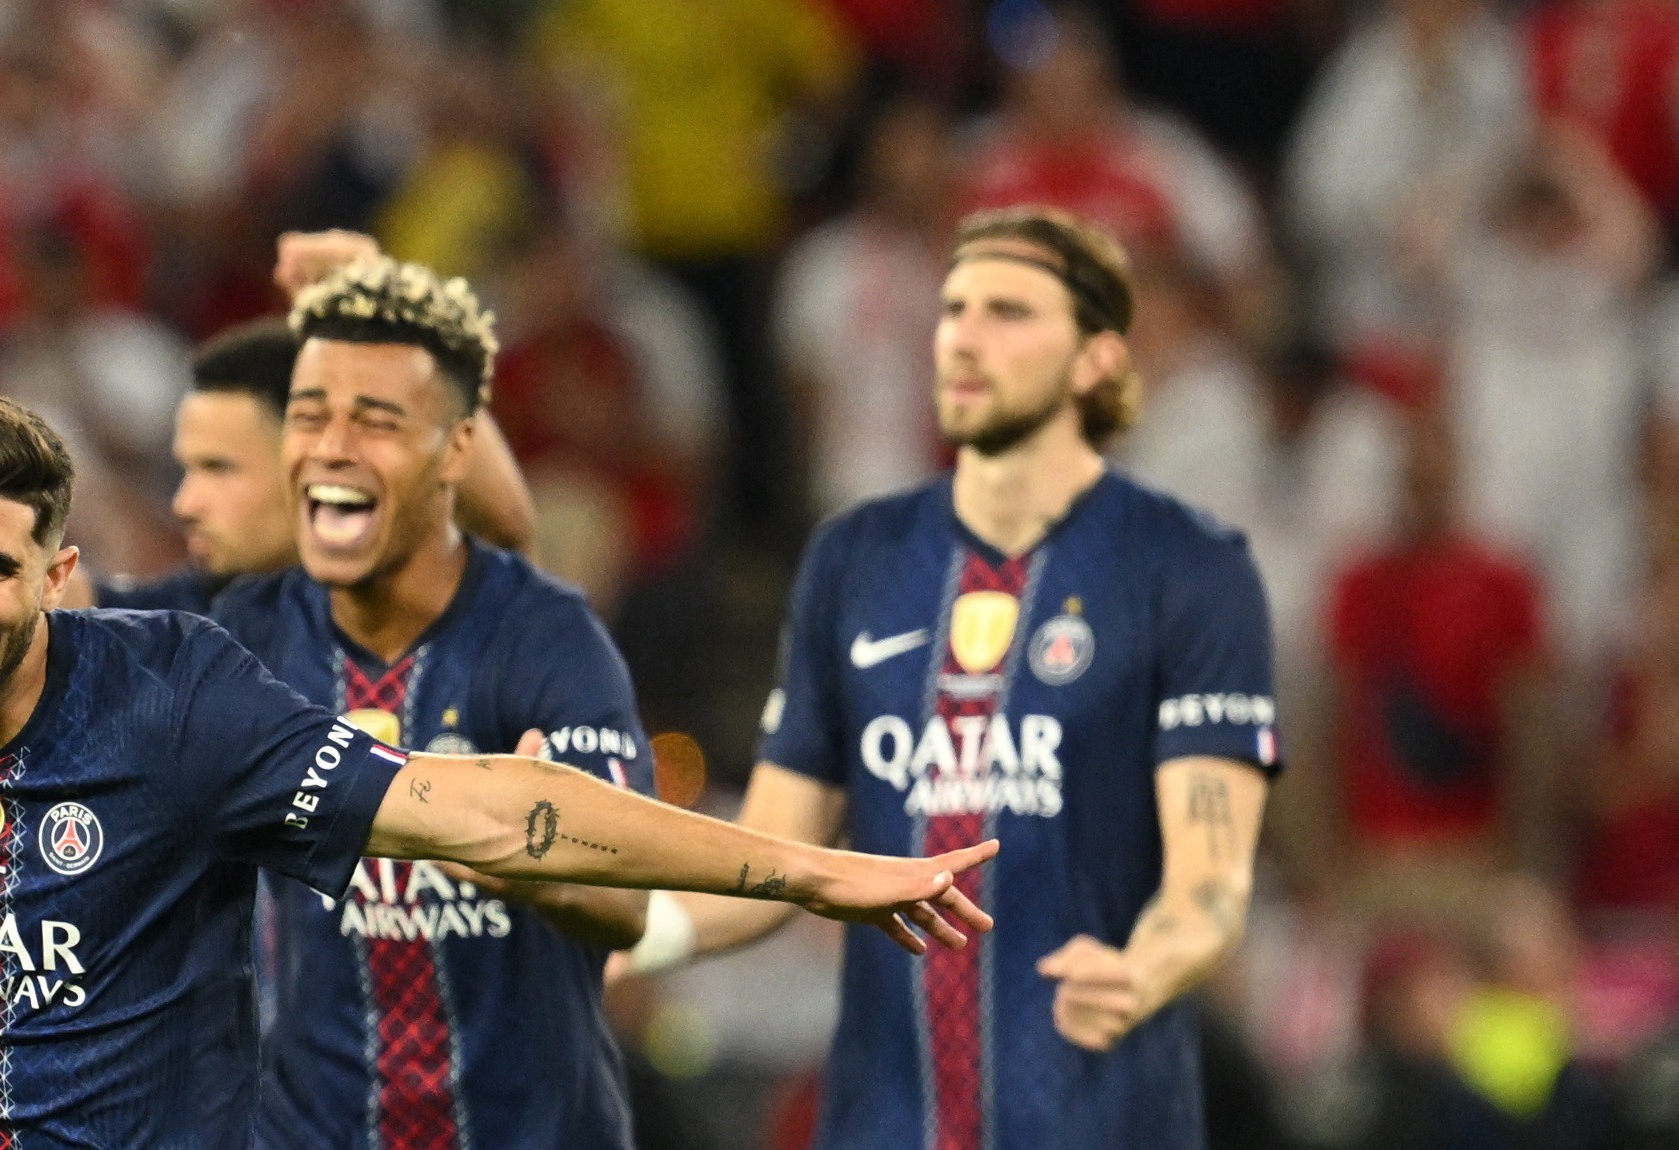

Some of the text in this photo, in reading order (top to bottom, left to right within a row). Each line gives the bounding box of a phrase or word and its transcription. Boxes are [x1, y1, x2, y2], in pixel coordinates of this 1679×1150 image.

[1158, 692, 1275, 731] BEYON
[860, 714, 1063, 791] QATAR
[50, 805, 93, 826] PARIS
[340, 897, 511, 941] AIRWAYS
